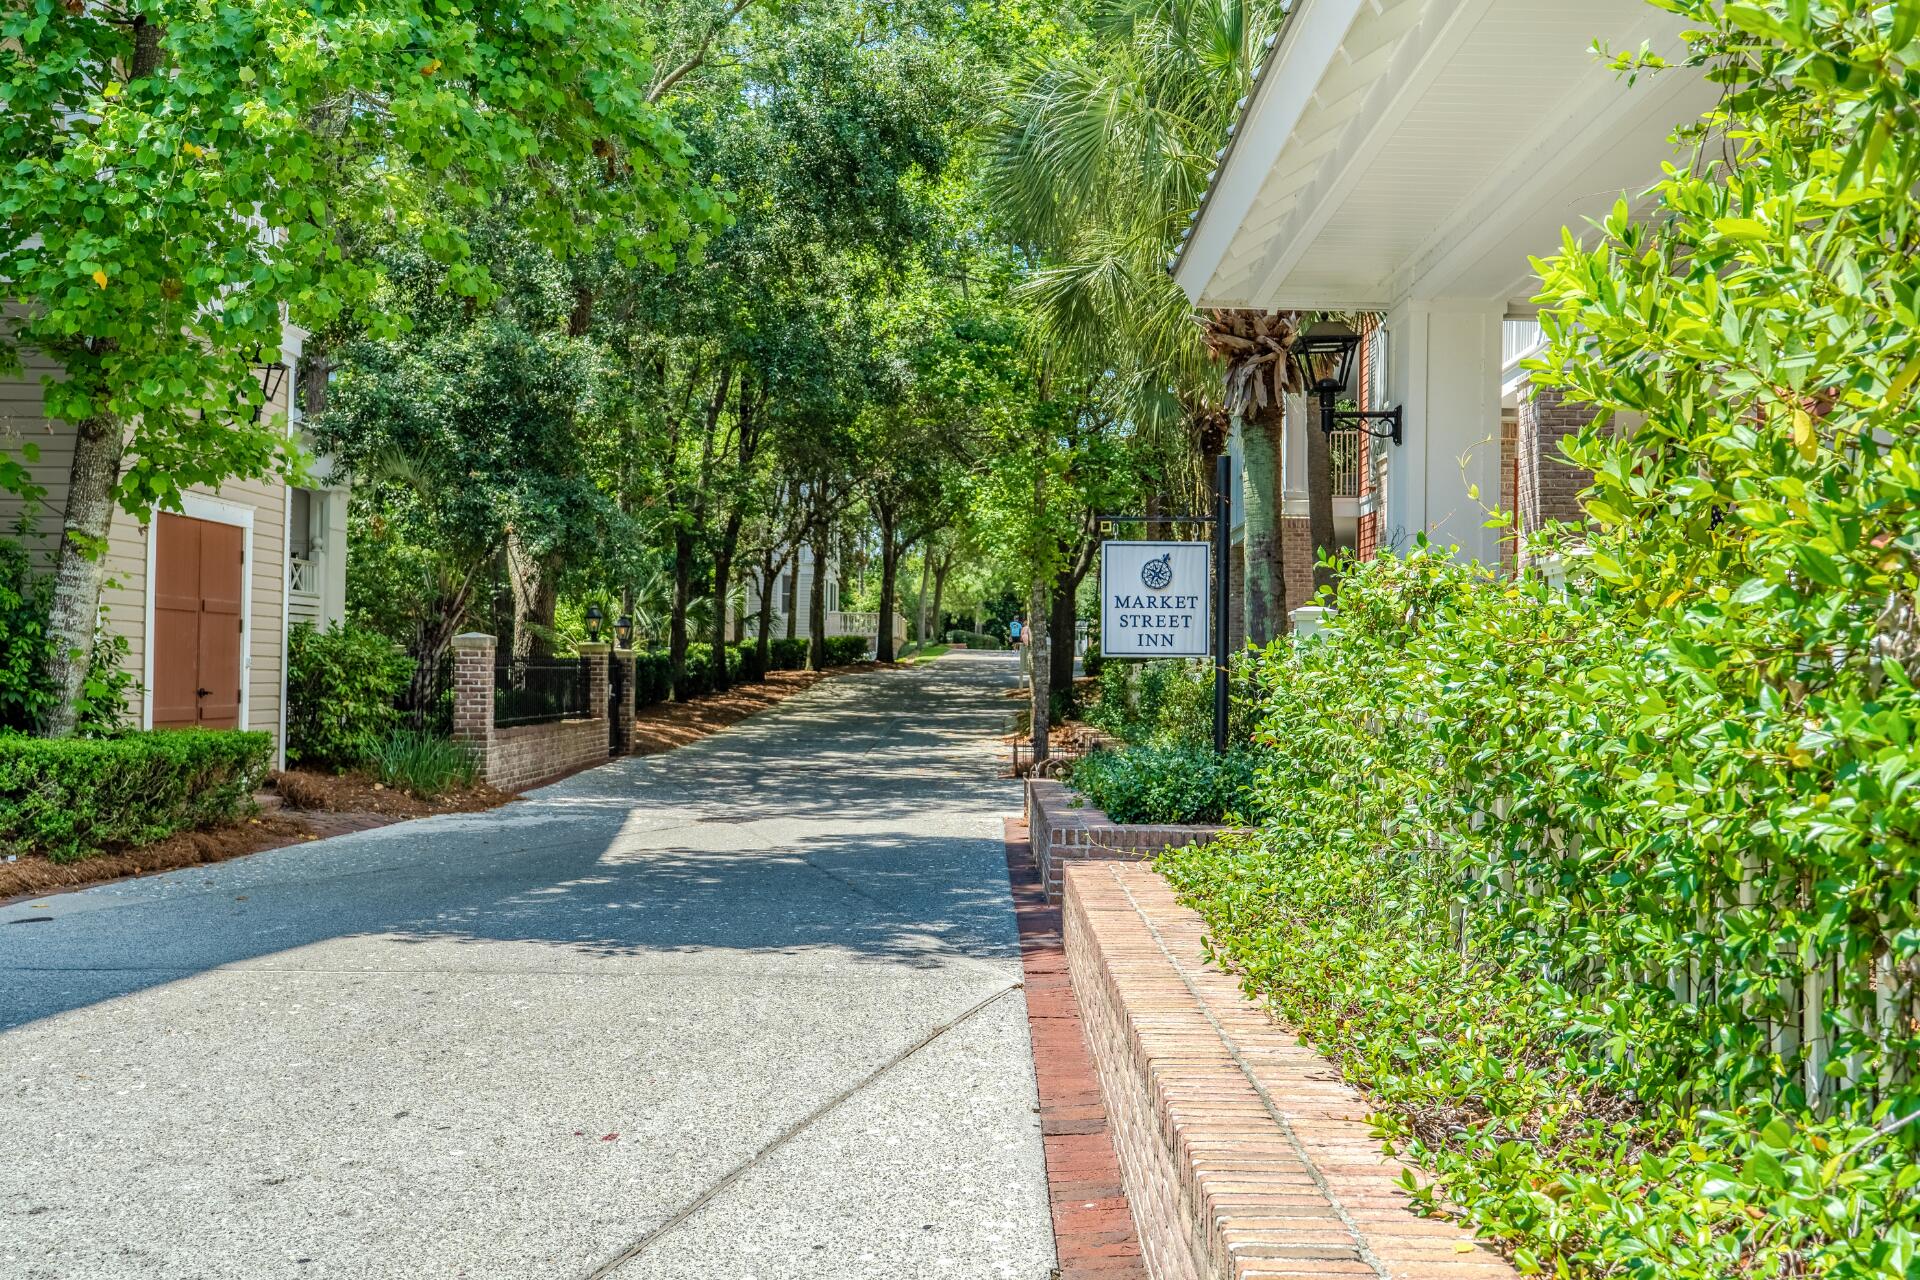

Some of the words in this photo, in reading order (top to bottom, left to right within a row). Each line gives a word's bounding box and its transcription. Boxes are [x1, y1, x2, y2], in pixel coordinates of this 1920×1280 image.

[1114, 595, 1199, 609] MARKET
[1119, 614, 1193, 628] STREET
[1137, 633, 1175, 647] INN
